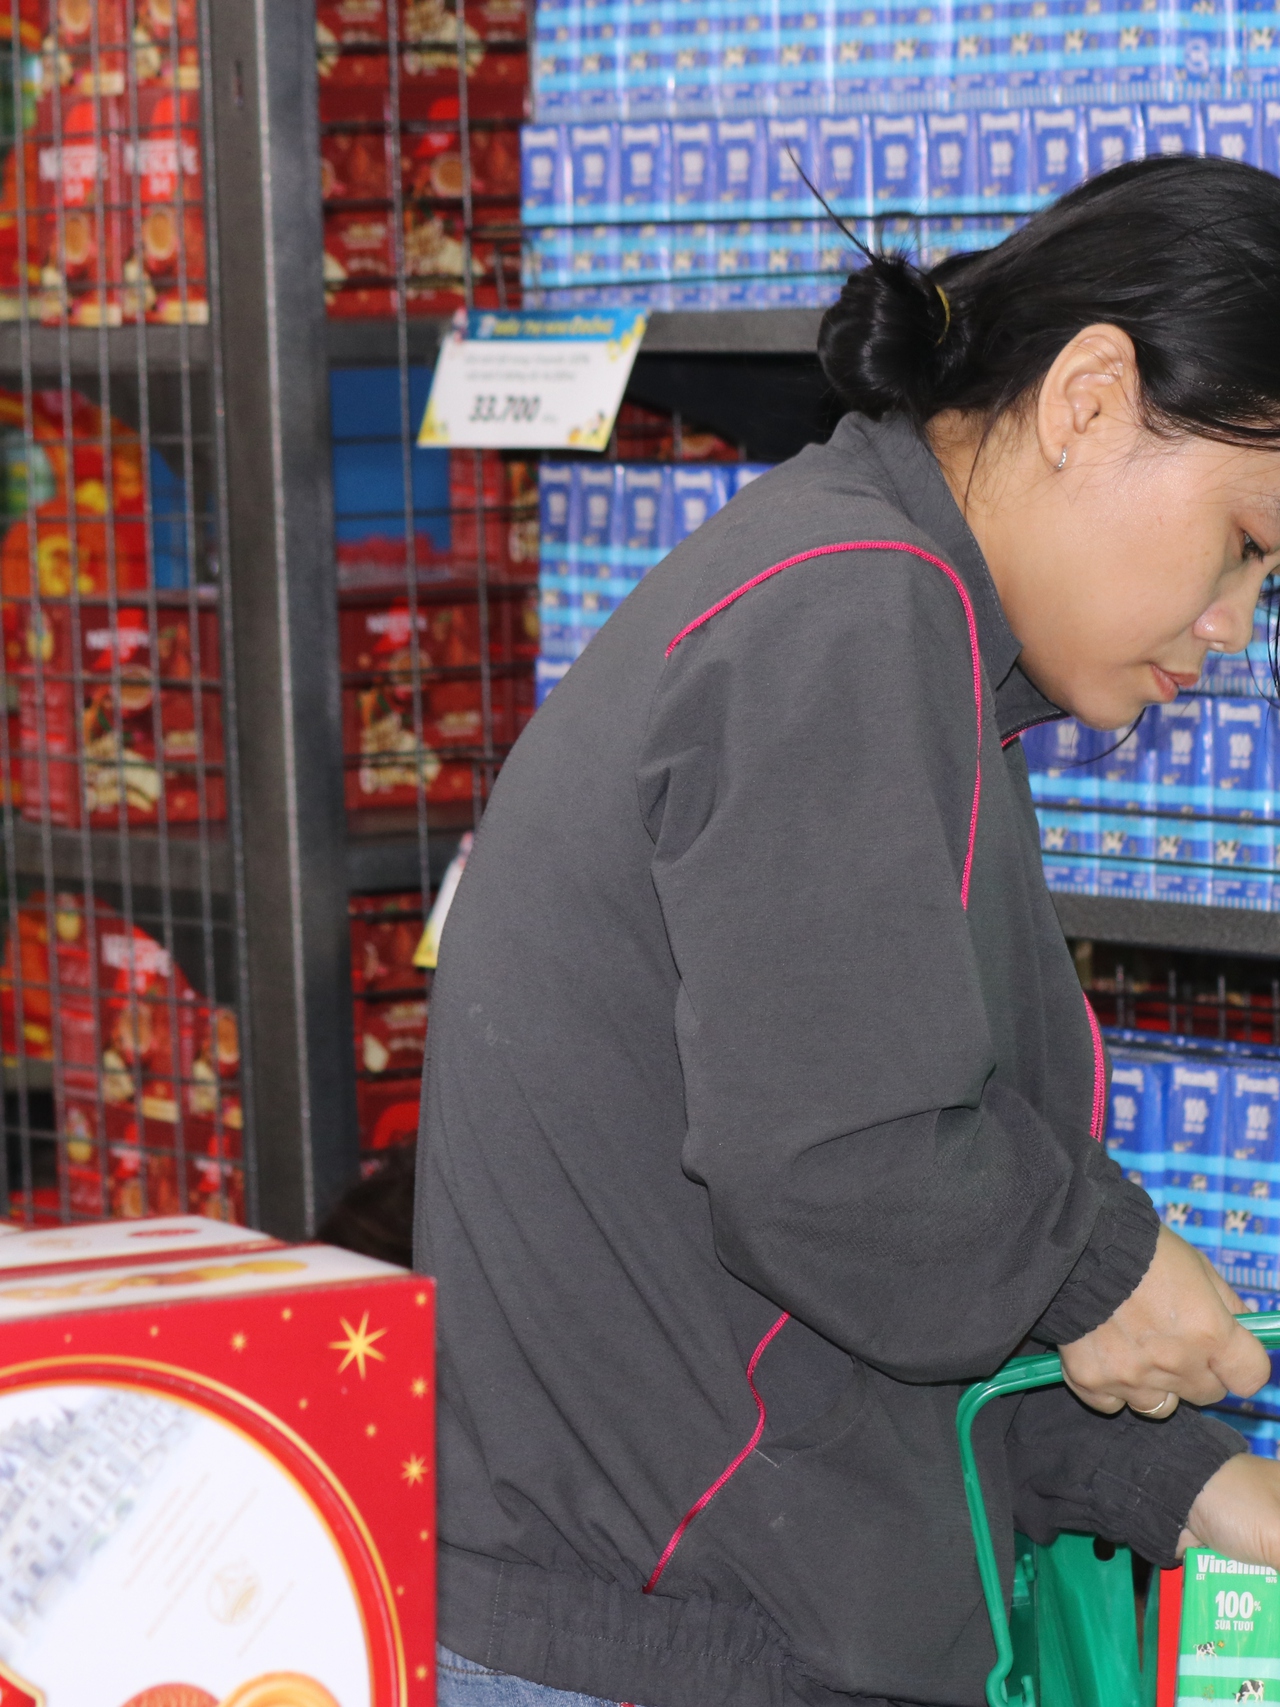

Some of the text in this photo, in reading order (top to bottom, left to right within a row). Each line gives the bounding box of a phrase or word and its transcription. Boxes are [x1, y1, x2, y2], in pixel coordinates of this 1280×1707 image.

[468, 394, 541, 423] 33.700
[1196, 1573, 1206, 1581] EST
[1265, 1576, 1278, 1584] 1976
[1215, 1590, 1262, 1619] 100%
